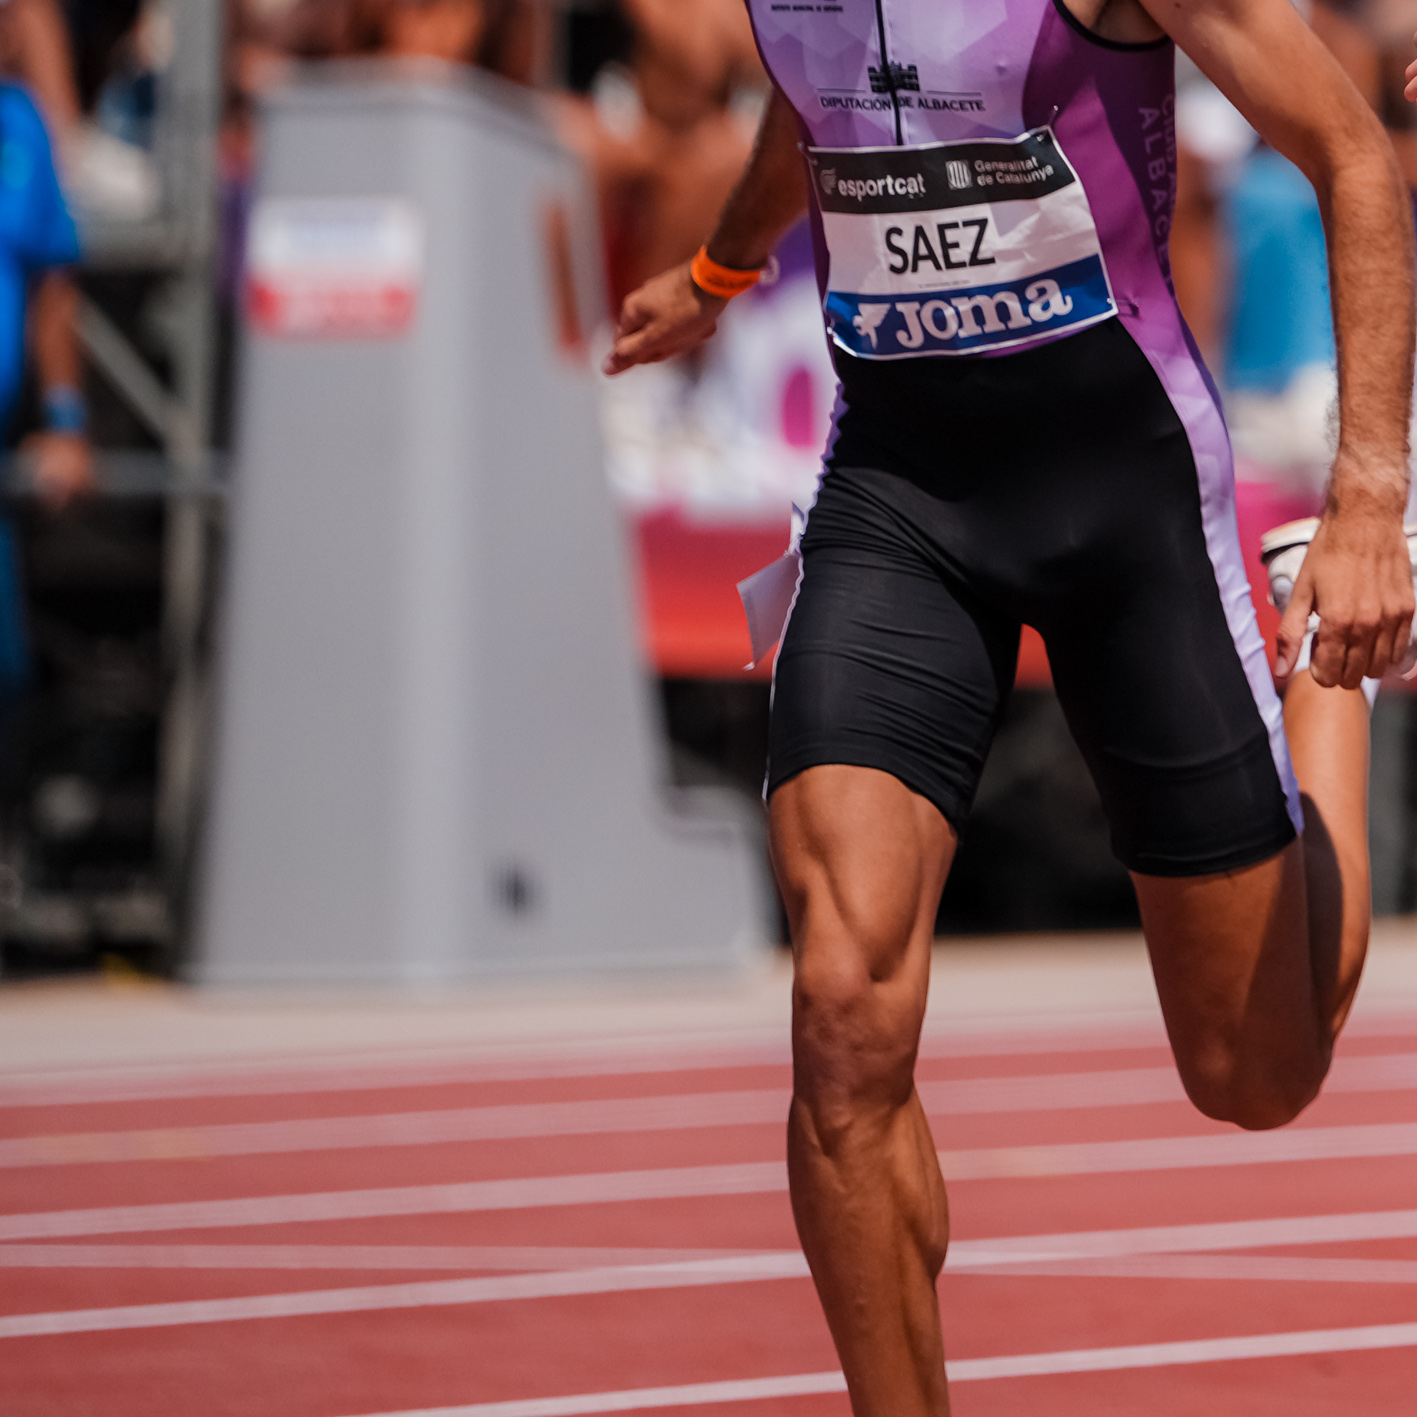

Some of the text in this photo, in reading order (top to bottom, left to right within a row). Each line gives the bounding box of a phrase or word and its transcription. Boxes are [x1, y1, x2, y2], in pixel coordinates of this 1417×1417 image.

[918, 97, 986, 112] ALBACETE
[974, 156, 1039, 172] Generalitat
[976, 164, 1054, 187] de Catalunya
[838, 173, 926, 202] esportcat
[884, 217, 996, 275] SAEZ
